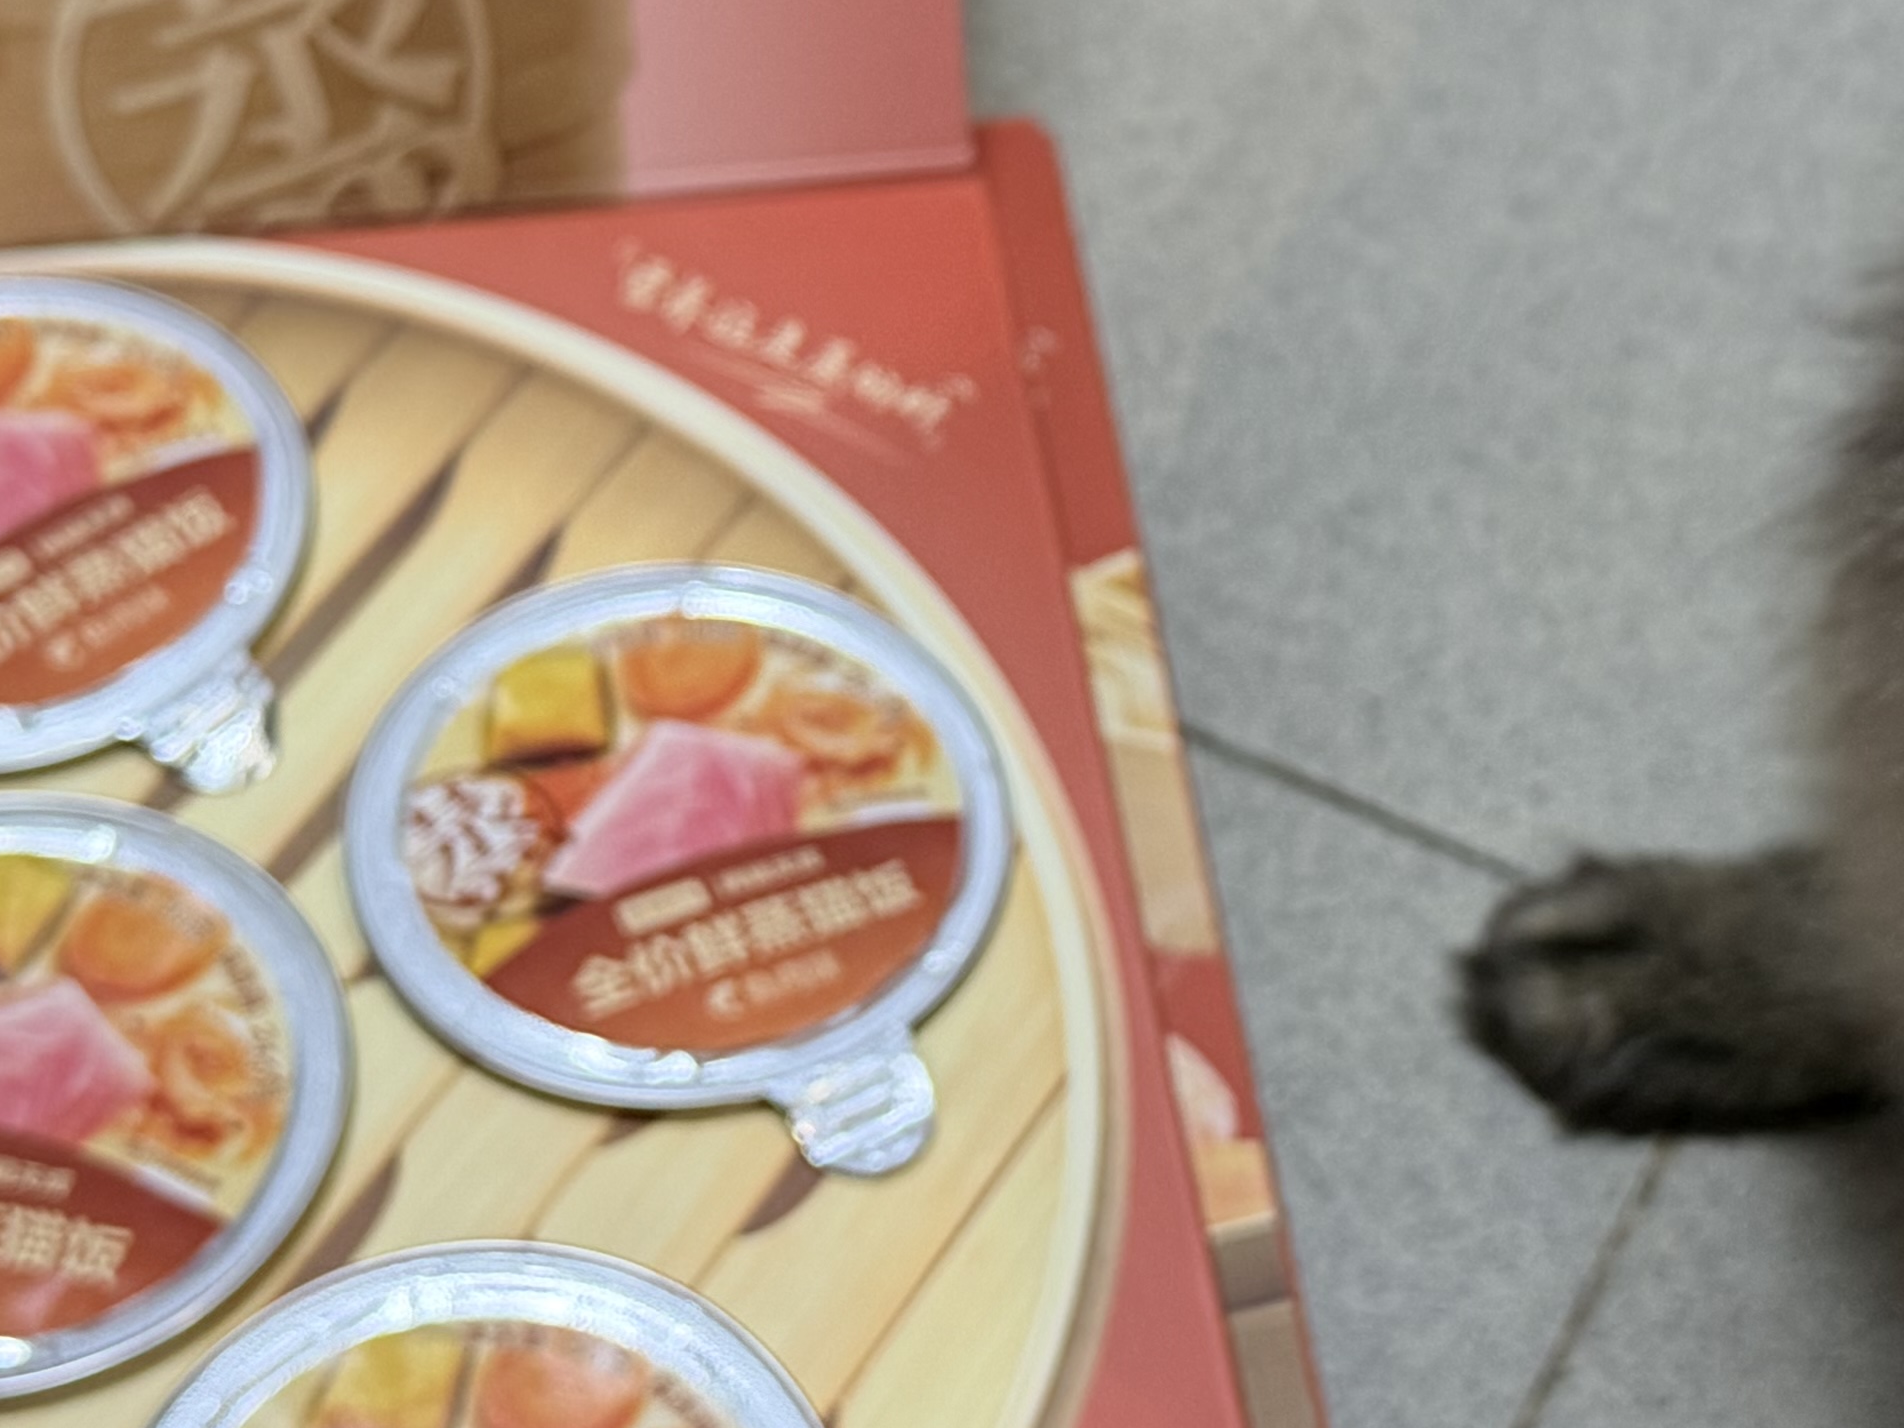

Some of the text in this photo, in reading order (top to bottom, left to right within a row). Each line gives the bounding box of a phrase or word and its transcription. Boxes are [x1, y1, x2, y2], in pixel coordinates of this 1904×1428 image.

[573, 859, 922, 1020] 全价鲜蒸猫饭
